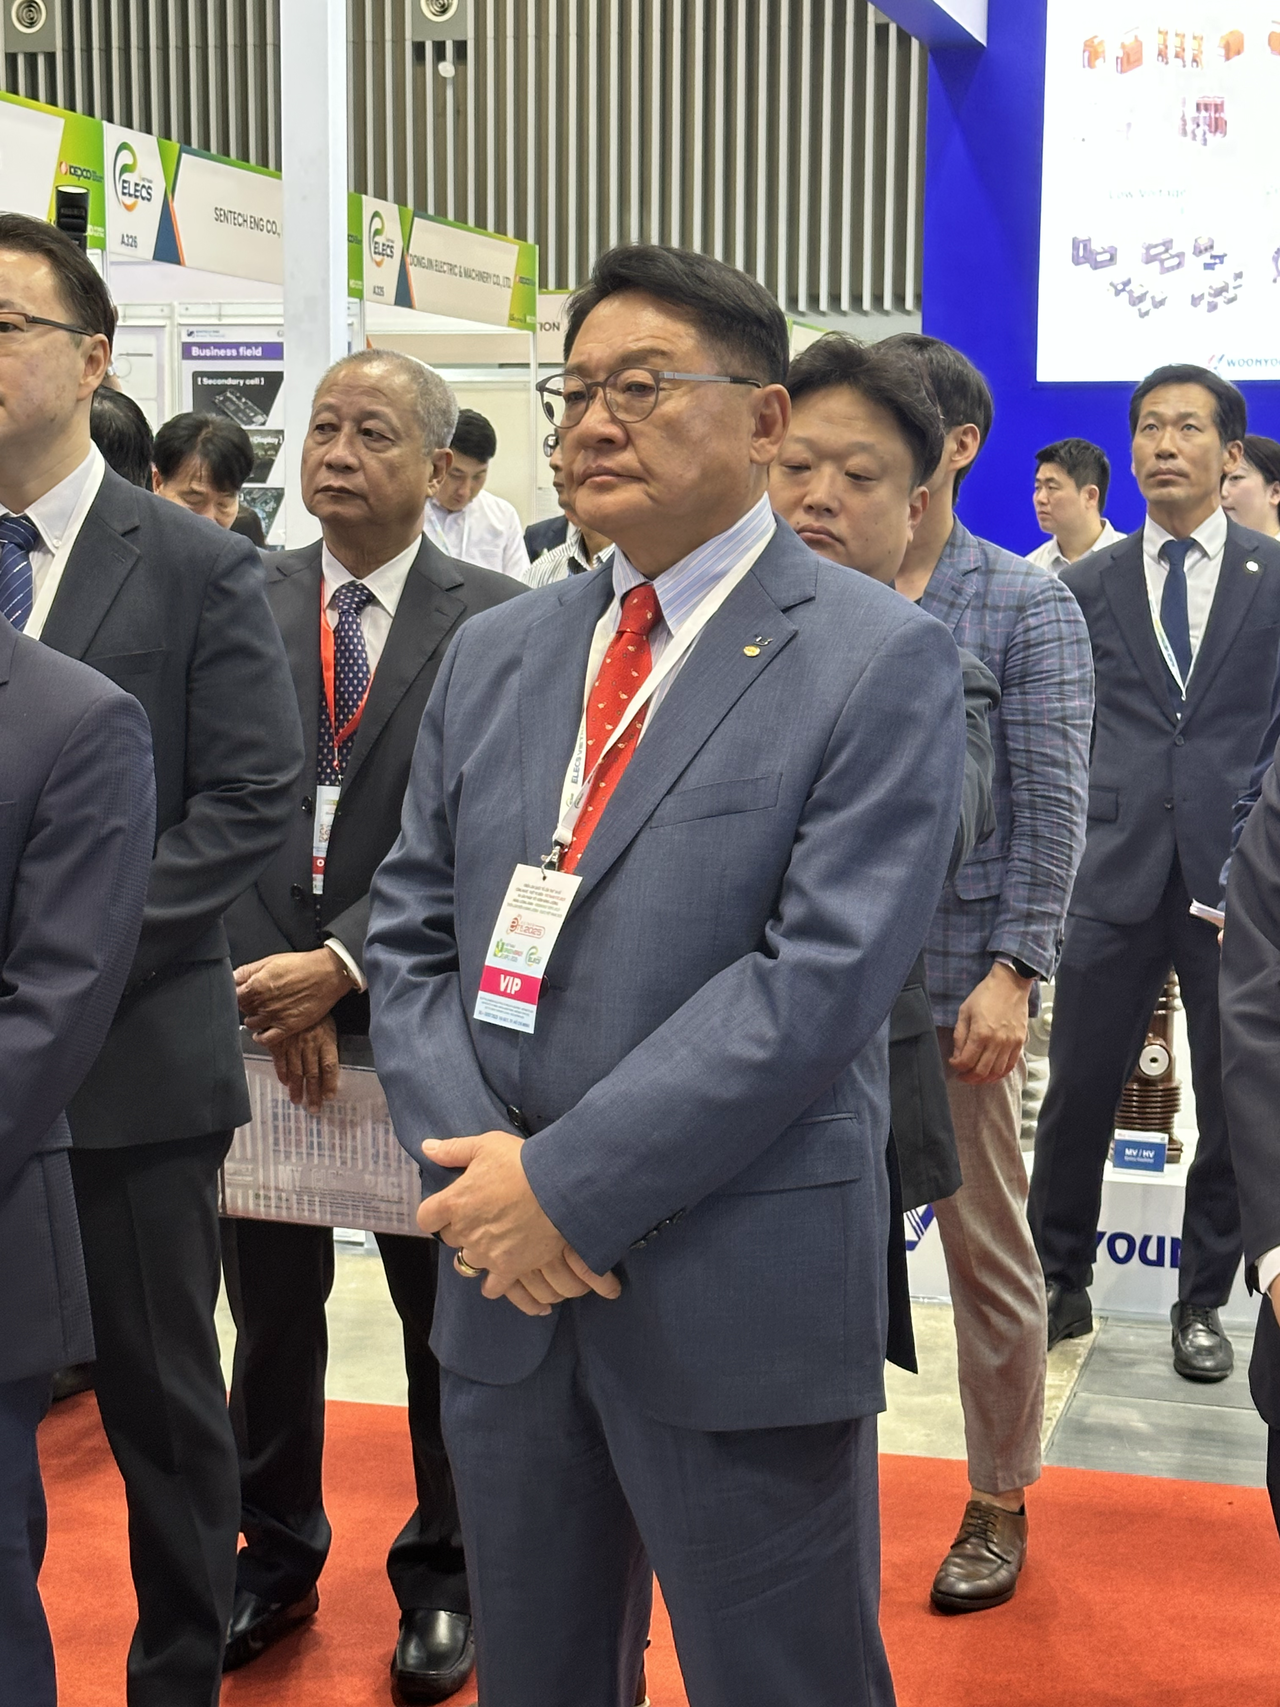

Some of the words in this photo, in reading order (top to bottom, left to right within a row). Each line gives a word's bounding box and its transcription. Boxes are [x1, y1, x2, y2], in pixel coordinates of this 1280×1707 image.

[121, 179, 153, 202] ELECS
[214, 206, 248, 228] SENTECH
[249, 214, 264, 232] ENG
[120, 233, 138, 249] A326
[373, 241, 394, 259] ELECS
[409, 253, 434, 271] DONGJIN
[434, 258, 458, 277] ELECTRIC
[463, 266, 491, 285] MACHINERY
[191, 346, 238, 357] Business
[239, 346, 262, 357] field
[1226, 358, 1280, 367] WOONYO
[202, 377, 244, 387] Secondary
[245, 377, 260, 385] cell
[571, 757, 582, 784] ELECS
[500, 974, 522, 995] VIP
[1125, 1147, 1138, 1156] MV
[1142, 1150, 1155, 1158] HV
